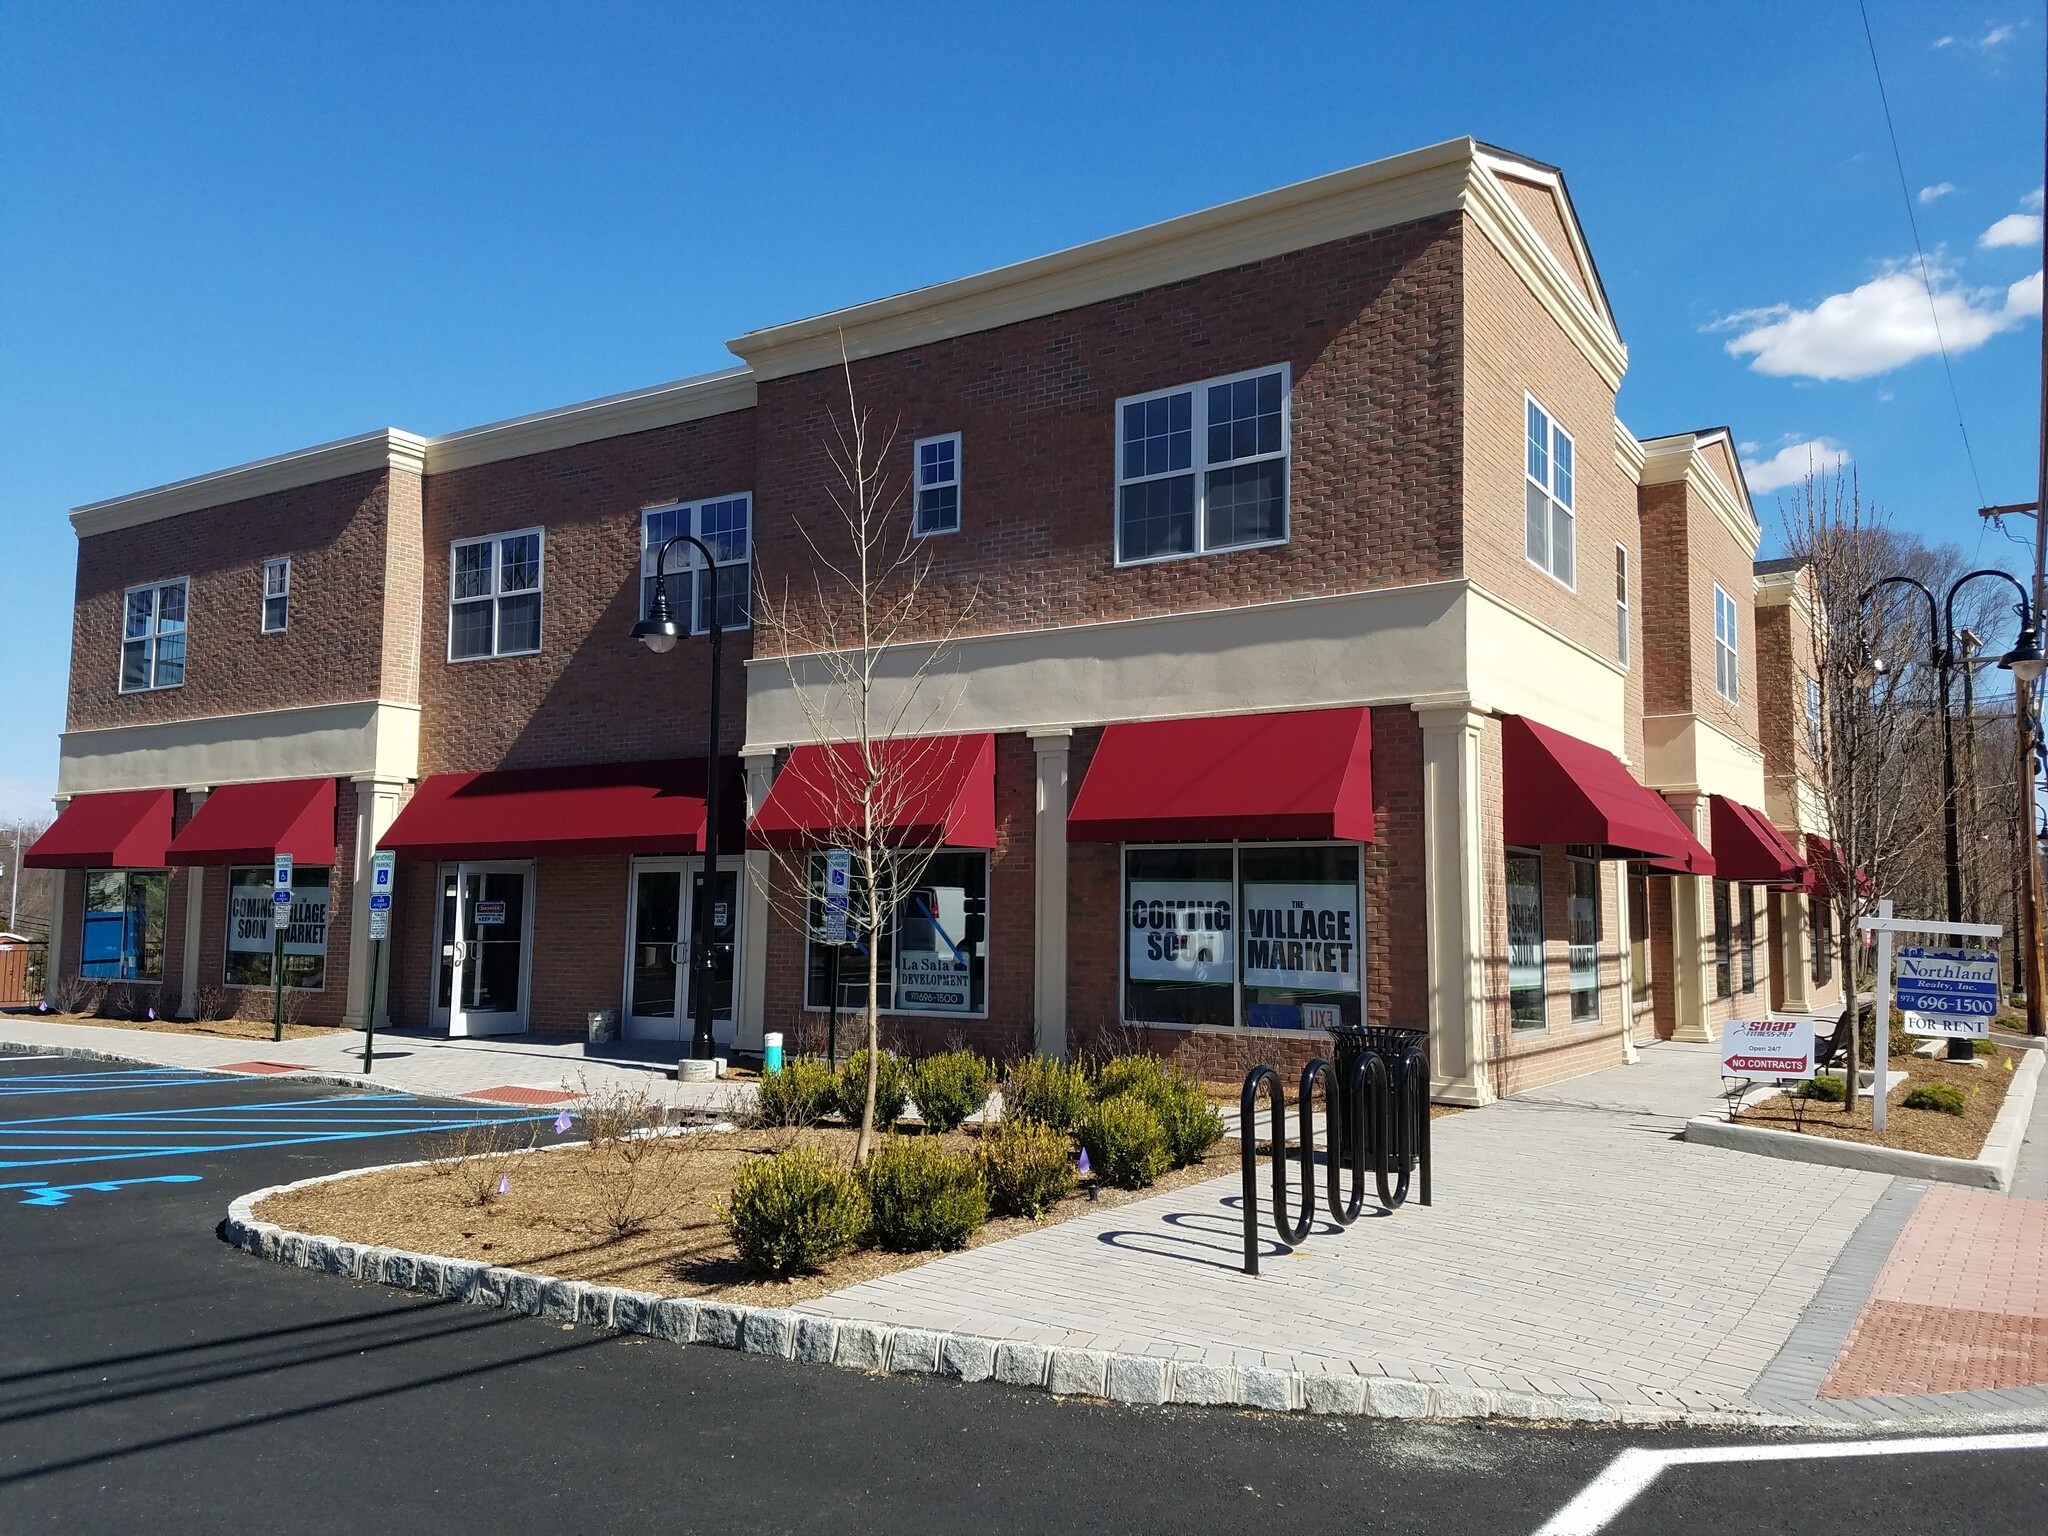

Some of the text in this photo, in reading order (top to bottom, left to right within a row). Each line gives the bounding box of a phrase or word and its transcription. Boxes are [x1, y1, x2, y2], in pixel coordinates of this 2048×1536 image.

[232, 898, 275, 919] COMING
[288, 903, 326, 923] ILLAGE
[1291, 901, 1304, 909] THE
[1131, 900, 1231, 931] COMING
[1248, 909, 1351, 941] VILLAGE
[237, 919, 267, 939] SOON
[1147, 931, 1214, 963] SOON
[1247, 940, 1353, 973] MARKET
[1511, 936, 1535, 967] SOON
[902, 957, 950, 972] La Sala
[1901, 960, 1994, 981] Northland
[901, 973, 969, 987] DEVELOPMENT
[1917, 980, 1978, 991] Realty, Inc.
[919, 992, 958, 1003] 696-1500
[1900, 994, 1993, 1014] 973 696-1500
[1309, 1009, 1333, 1029] EXIT
[1908, 1017, 1985, 1033] FOR RENT
[1732, 1059, 1803, 1070] NO CONTRACTS
